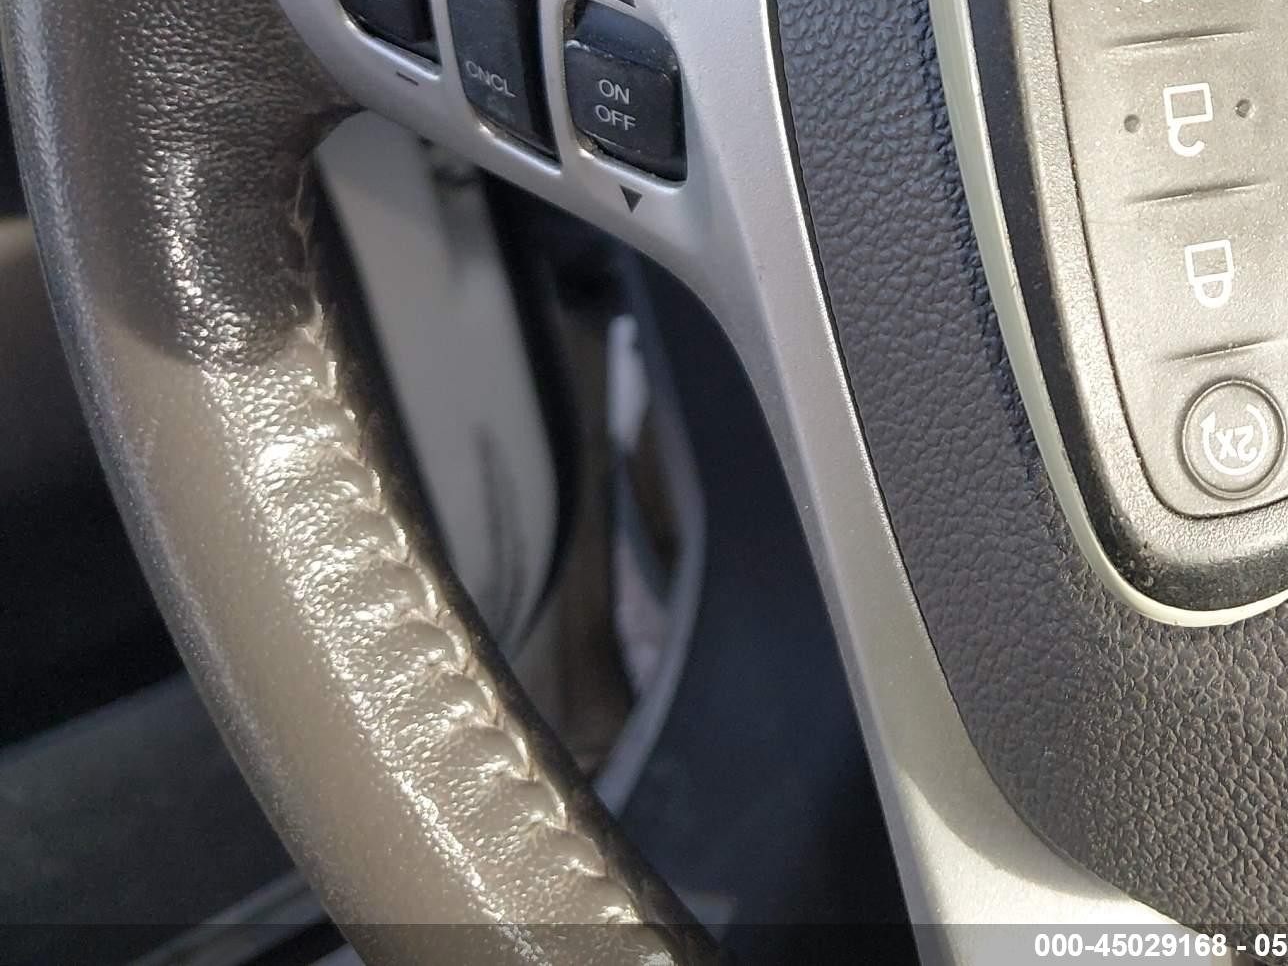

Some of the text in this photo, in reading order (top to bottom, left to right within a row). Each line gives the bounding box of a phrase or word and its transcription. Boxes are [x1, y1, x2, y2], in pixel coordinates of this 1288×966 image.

[466, 61, 515, 98] CNCL
[599, 79, 630, 105] ON
[595, 104, 636, 132] OFF
